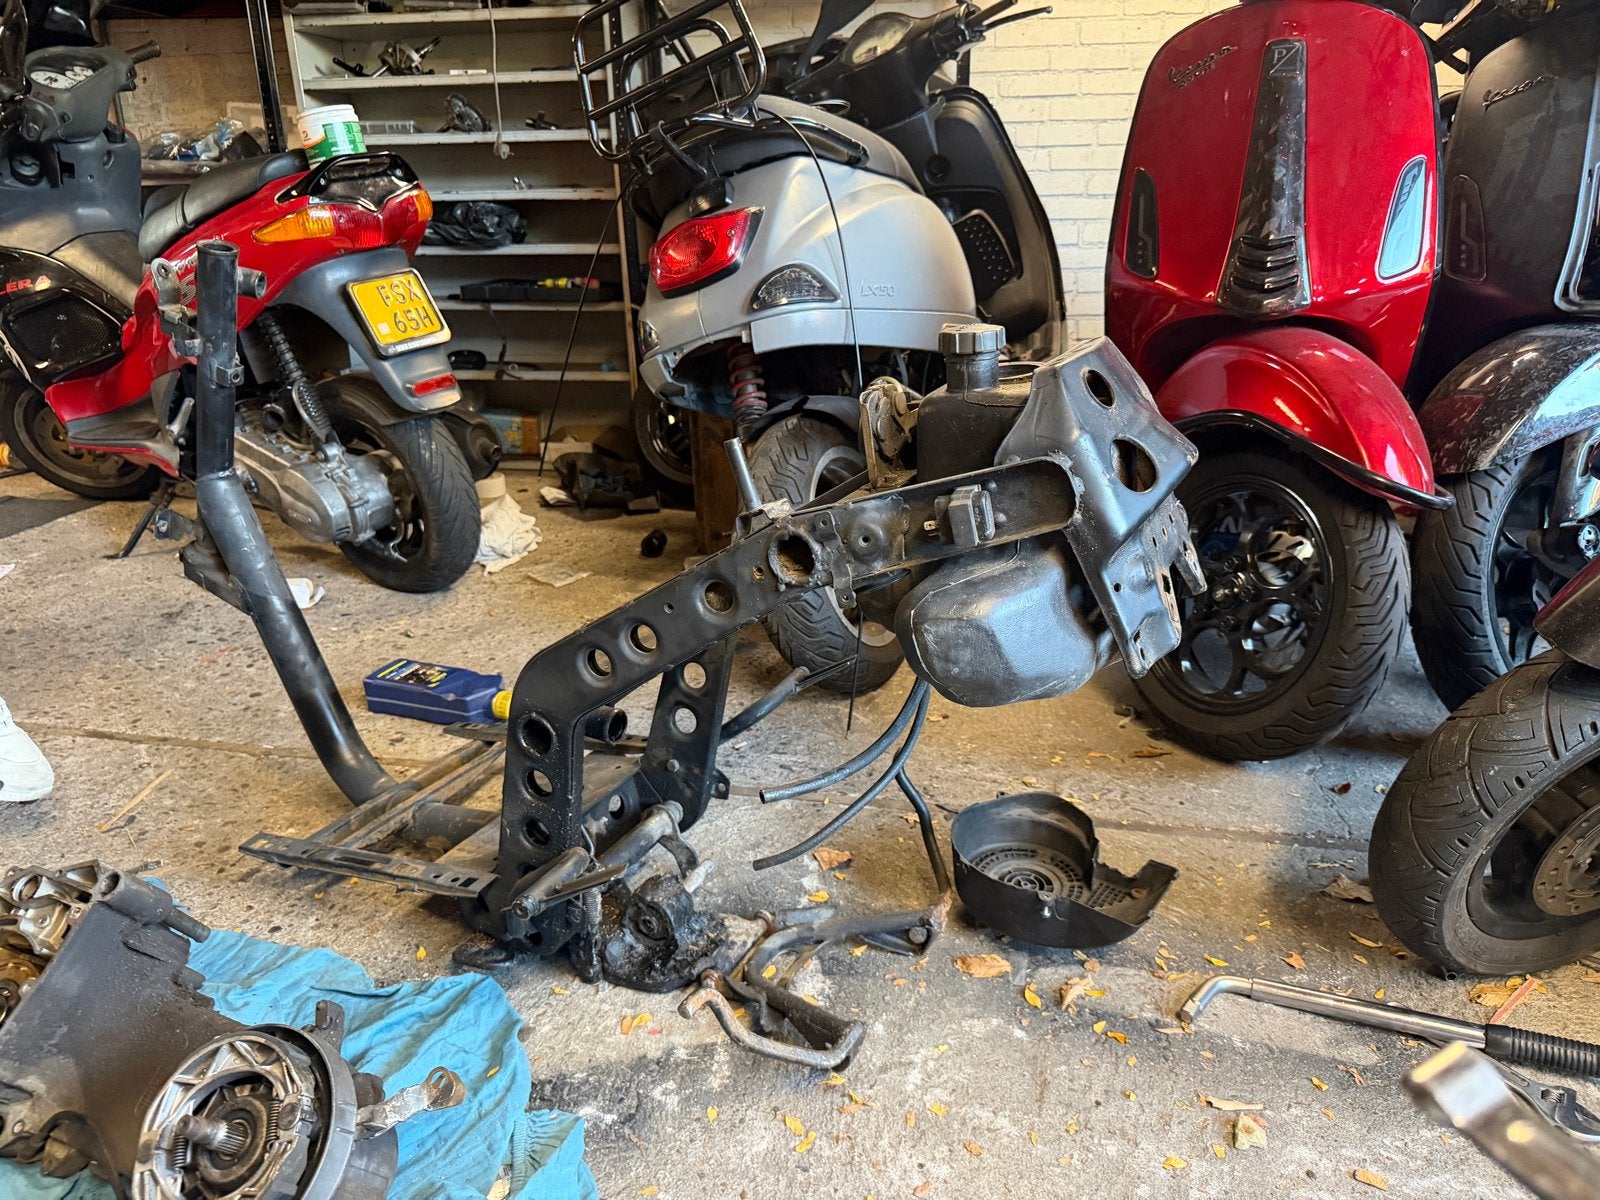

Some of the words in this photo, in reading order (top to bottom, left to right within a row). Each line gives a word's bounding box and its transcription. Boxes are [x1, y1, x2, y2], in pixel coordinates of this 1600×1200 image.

[0, 275, 51, 295] ERA
[376, 279, 421, 307] FSX
[393, 305, 434, 333] 65H
